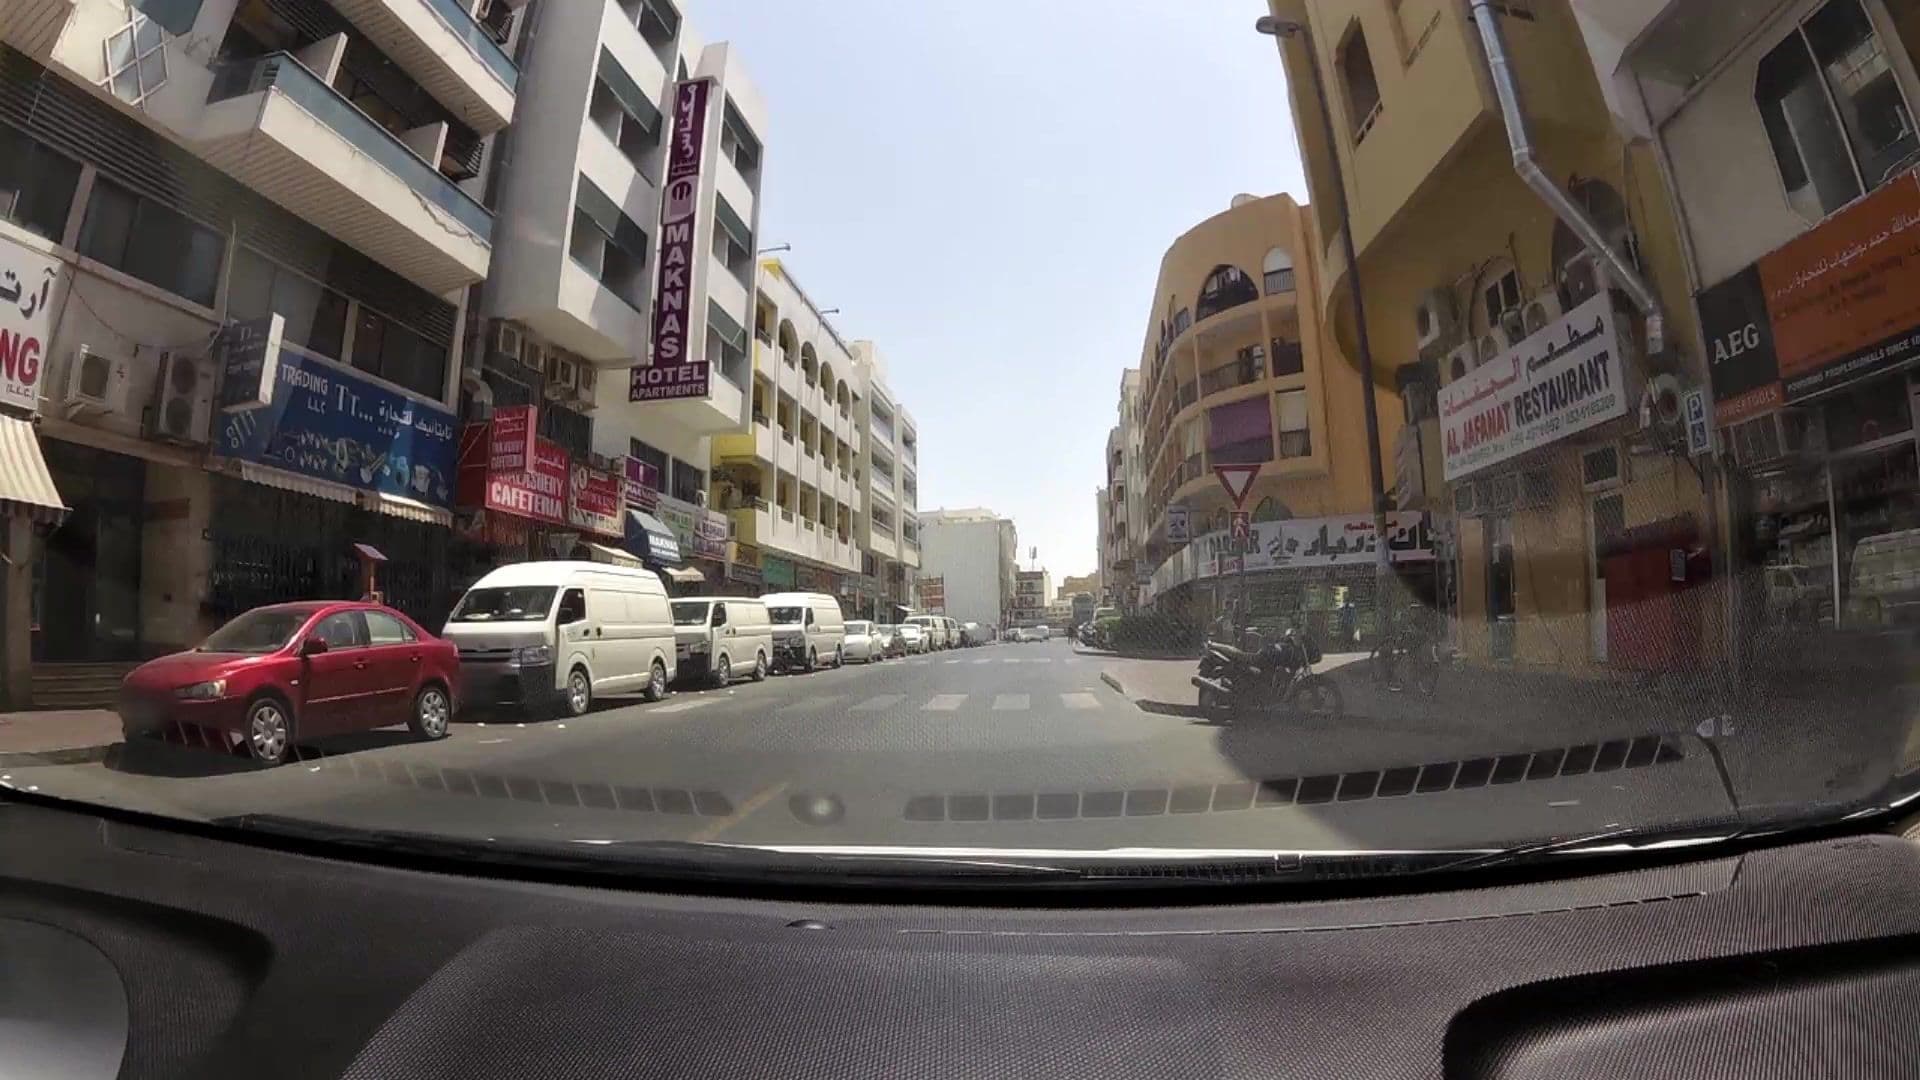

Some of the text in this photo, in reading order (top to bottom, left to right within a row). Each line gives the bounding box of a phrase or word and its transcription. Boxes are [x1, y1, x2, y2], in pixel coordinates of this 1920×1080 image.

[660, 223, 689, 358] MAKNAS
[1526, 314, 1604, 384] مطعم
[1713, 322, 1761, 365] AEG
[282, 364, 328, 395] TRADING
[631, 383, 705, 400] APARTMENTS
[632, 364, 705, 386] HOTEL
[1513, 350, 1610, 428] RESTAURANT
[491, 480, 562, 519] CAFETERIA
